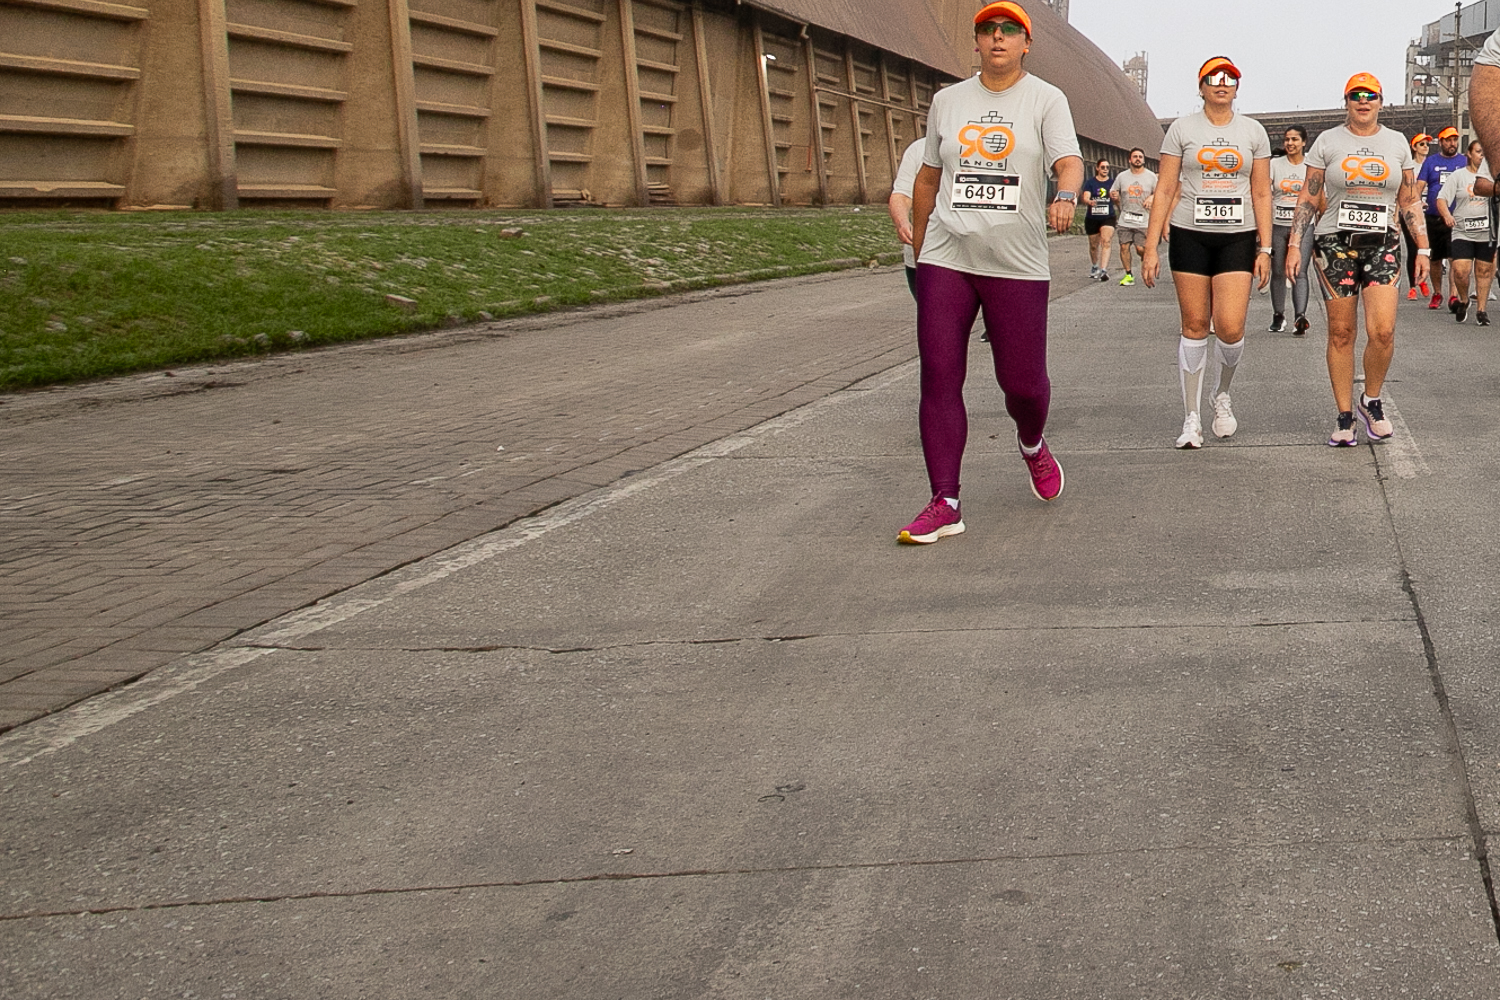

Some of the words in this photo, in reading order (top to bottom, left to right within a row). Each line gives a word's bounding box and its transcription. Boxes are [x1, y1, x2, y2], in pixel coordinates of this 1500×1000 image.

[958, 124, 1016, 161] 90
[963, 159, 1004, 168] ANOS
[1197, 147, 1244, 173] 90
[1341, 156, 1390, 182] 90
[965, 184, 1005, 201] 6491
[1204, 205, 1234, 217] 5161
[1348, 210, 1378, 224] 6328
